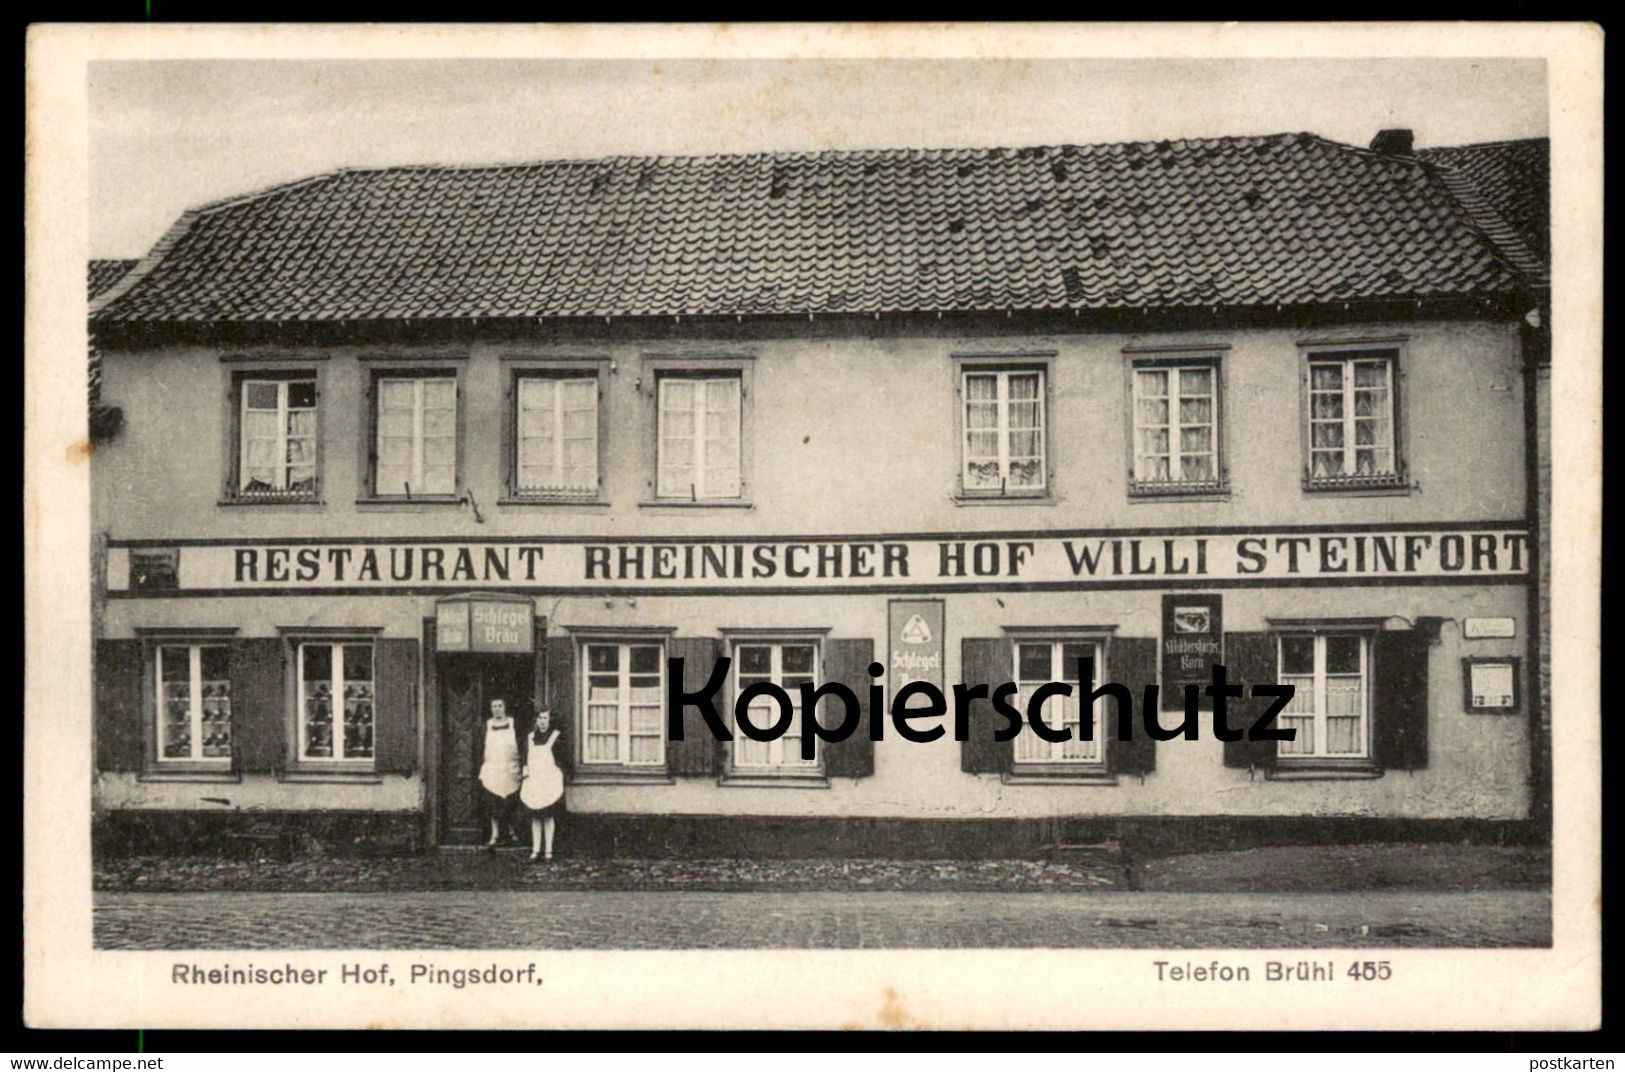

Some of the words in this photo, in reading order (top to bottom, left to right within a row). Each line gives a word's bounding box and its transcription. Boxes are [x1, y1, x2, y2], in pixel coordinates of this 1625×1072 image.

[235, 545, 544, 581] RESTAURANT
[585, 542, 911, 580] RHEINISCHER
[939, 540, 1034, 577] HOF
[1063, 539, 1208, 575] WILLI
[1238, 534, 1528, 574] STEINFORT
[172, 963, 328, 985] Rheinischer
[341, 963, 395, 987] Hof,
[410, 963, 543, 989] Pingsdorf,
[1154, 961, 1250, 982] Telefon
[1266, 961, 1333, 982] Brühl
